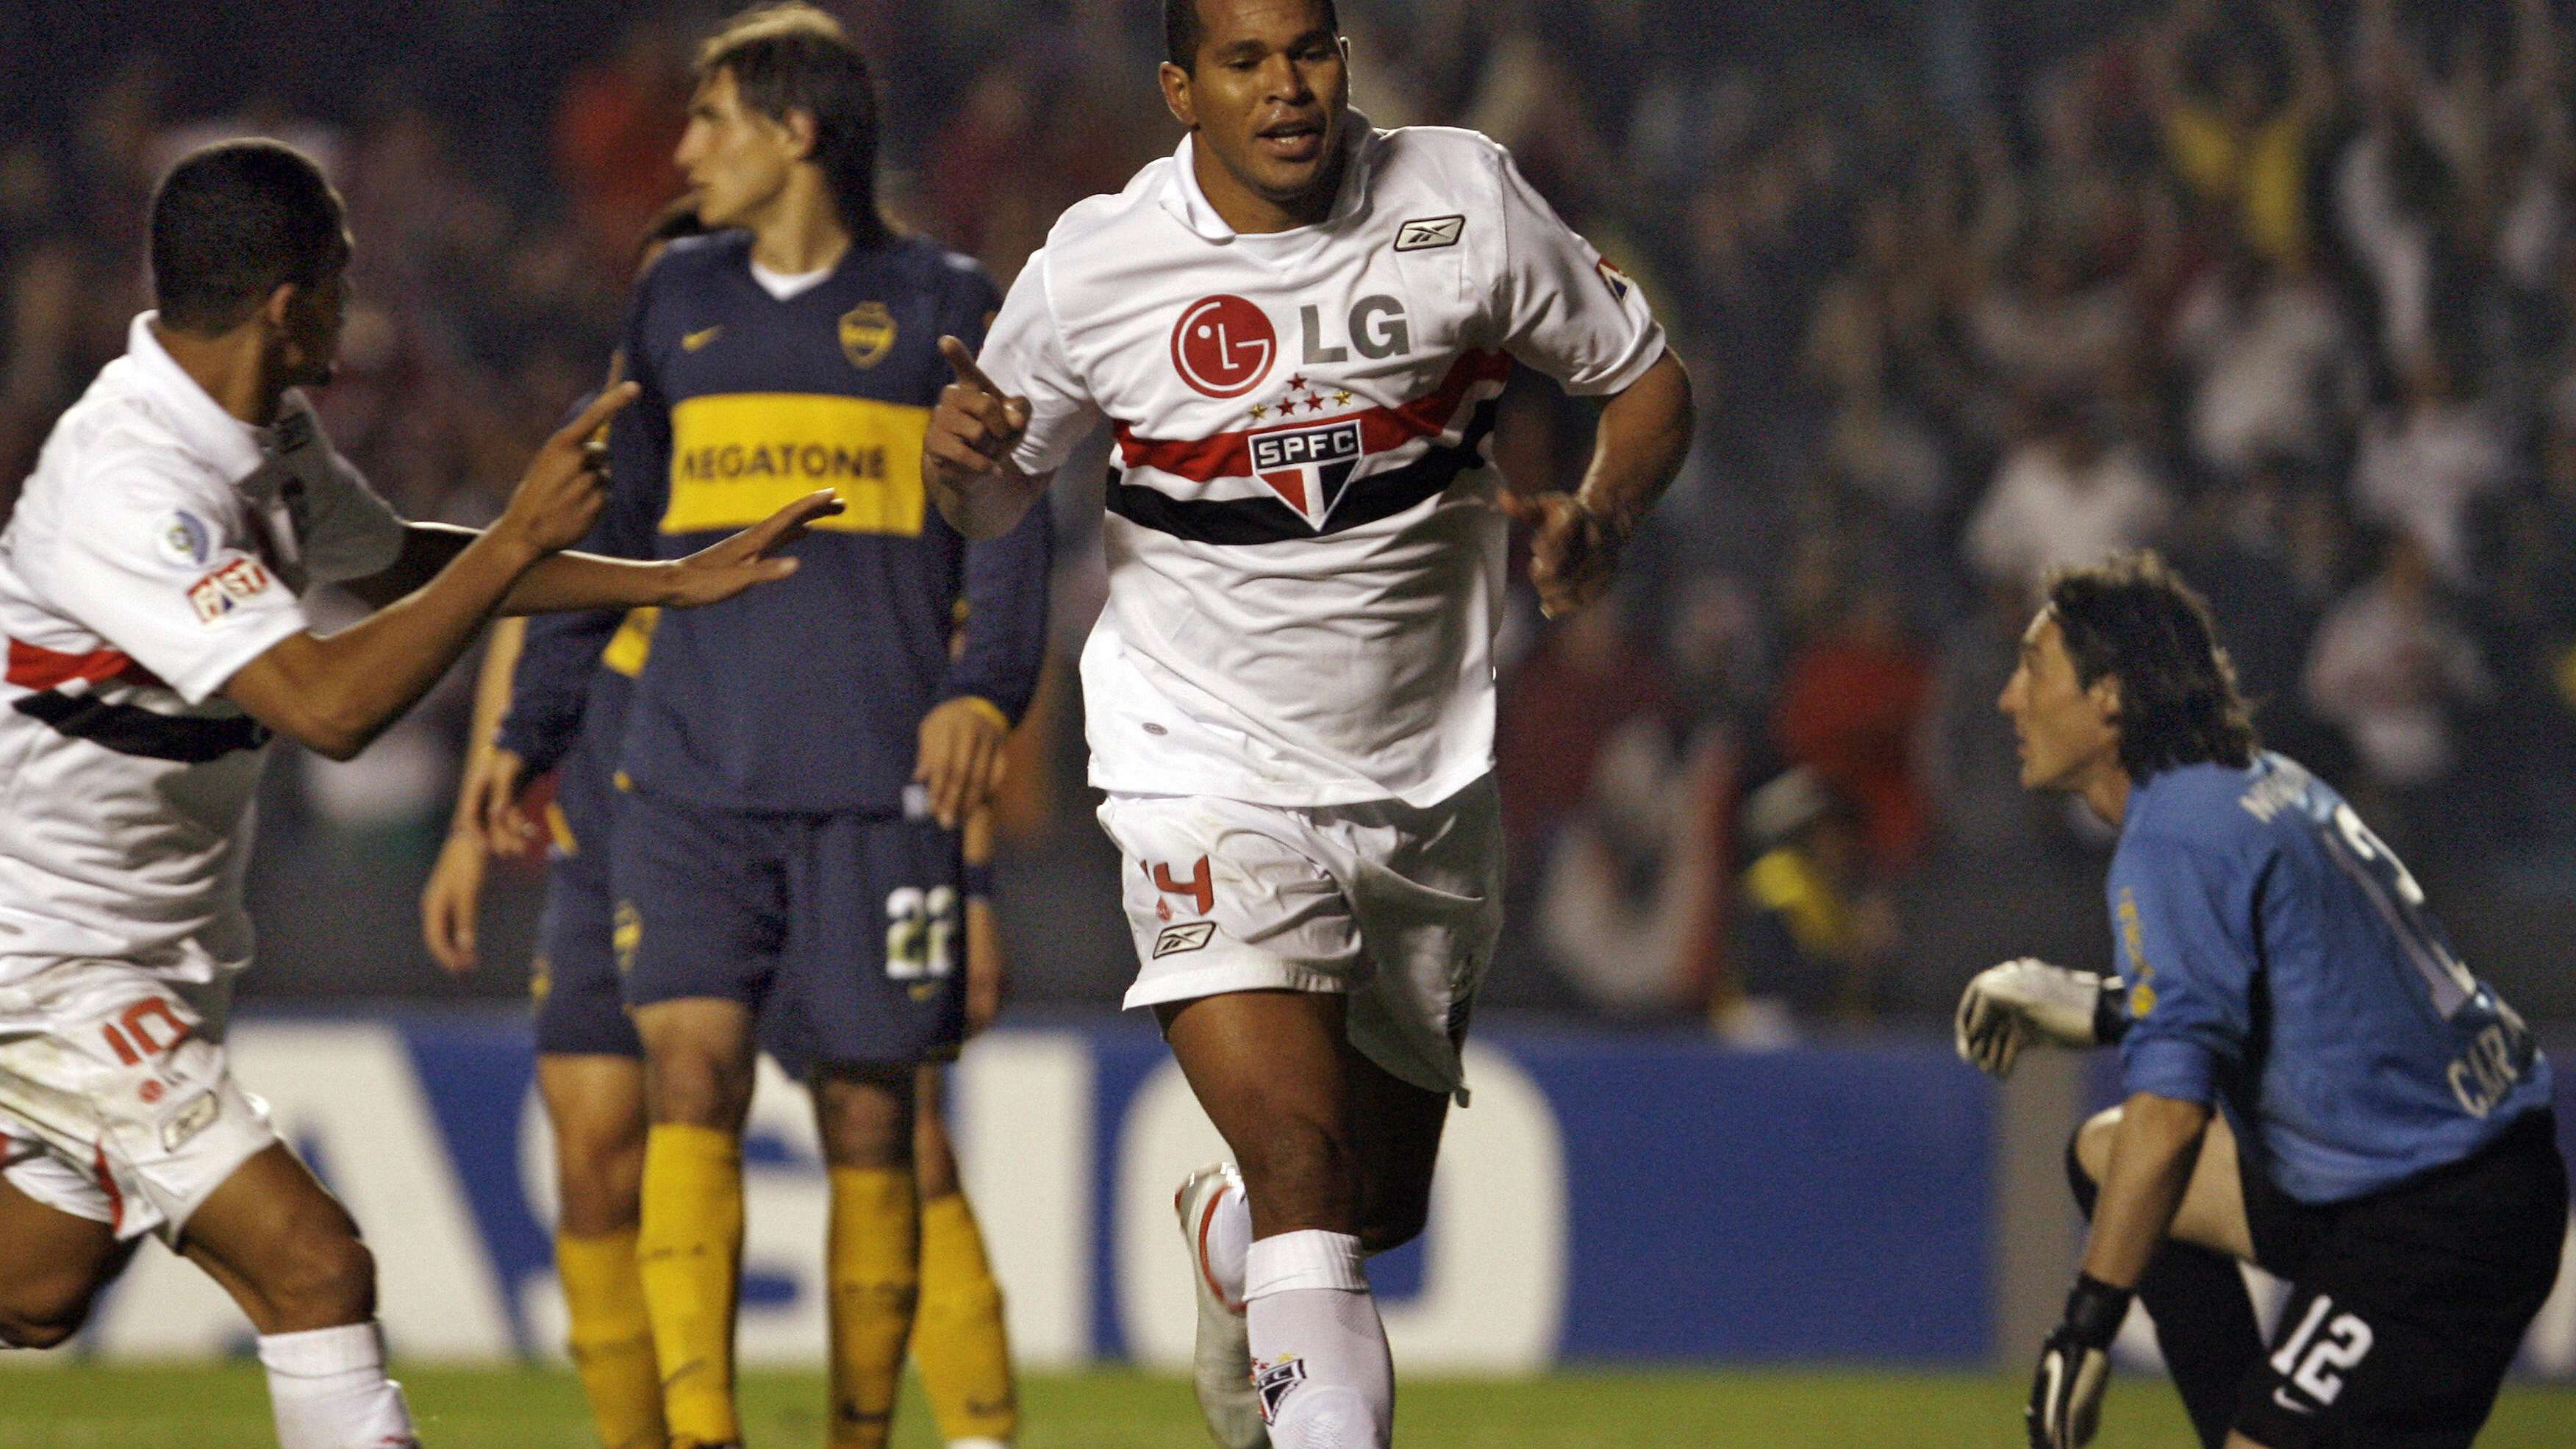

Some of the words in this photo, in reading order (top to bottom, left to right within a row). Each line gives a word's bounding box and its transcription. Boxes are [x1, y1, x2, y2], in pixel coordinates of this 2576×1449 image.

[1300, 295, 1410, 365] LG
[1258, 429, 1355, 465] SPFC
[103, 996, 190, 1067] 10
[0, 1023, 1575, 1366] AIO
[2272, 1295, 2373, 1405] 12
